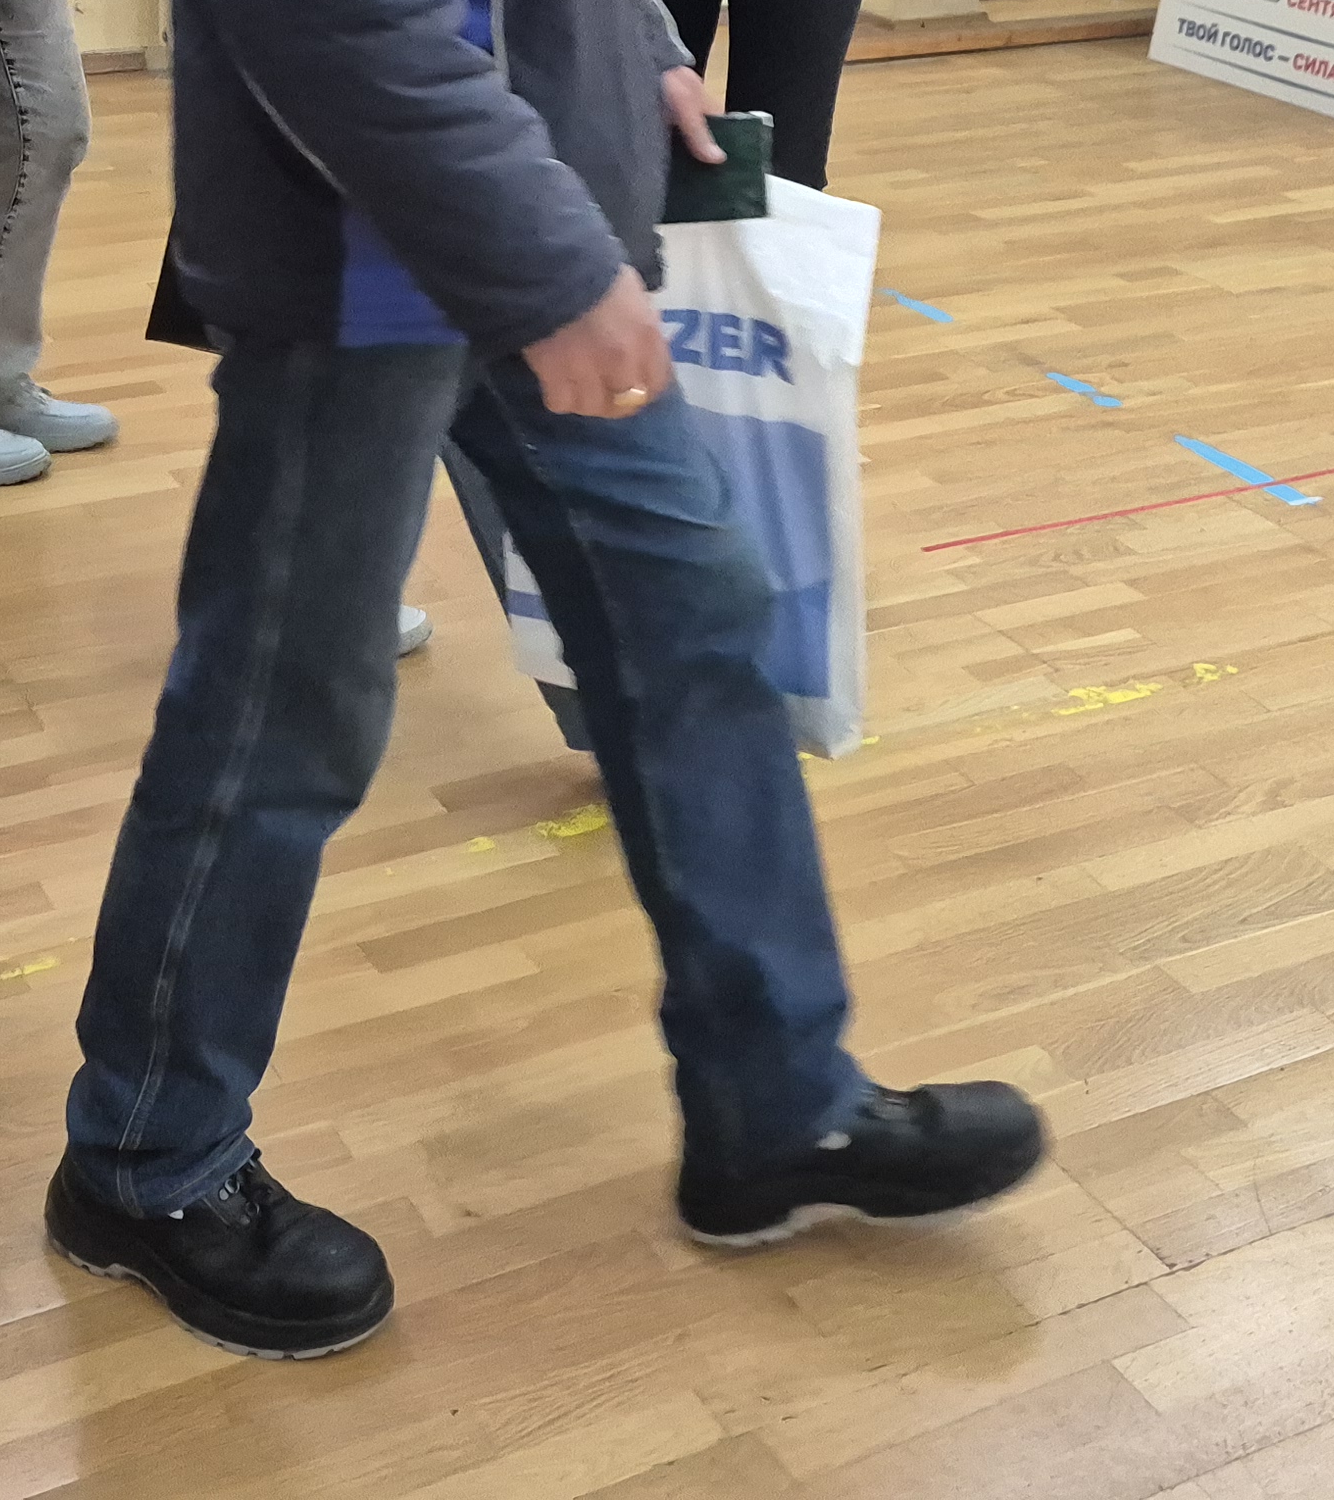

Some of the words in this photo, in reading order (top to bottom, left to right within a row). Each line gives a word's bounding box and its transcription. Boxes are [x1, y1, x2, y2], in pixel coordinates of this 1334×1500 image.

[1177, 18, 1219, 44] ТВОЙ
[1220, 31, 1276, 62] ГОЛОС
[661, 309, 795, 385] ZER
